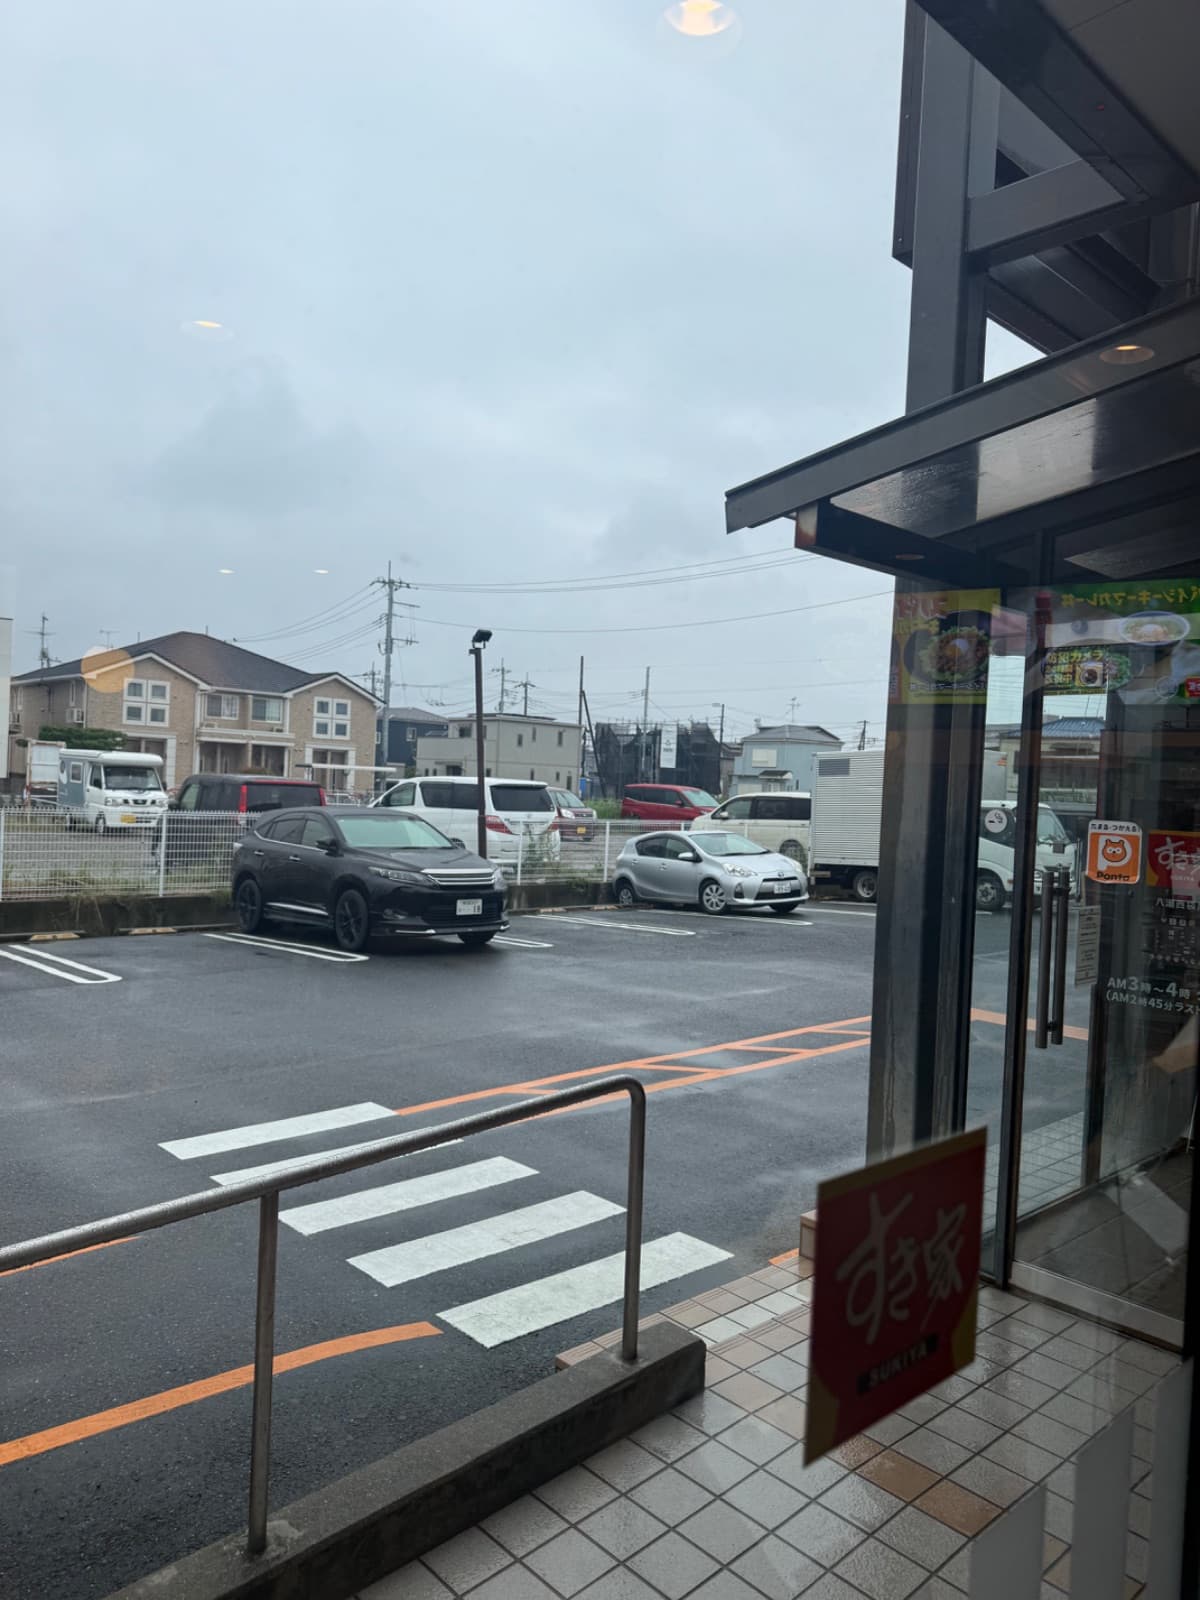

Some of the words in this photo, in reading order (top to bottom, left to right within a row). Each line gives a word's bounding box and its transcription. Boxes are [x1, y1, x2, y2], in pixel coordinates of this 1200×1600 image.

[1096, 871, 1130, 881] Ponta
[835, 1191, 967, 1345] すき家
[868, 1340, 929, 1388] SUKIYA
